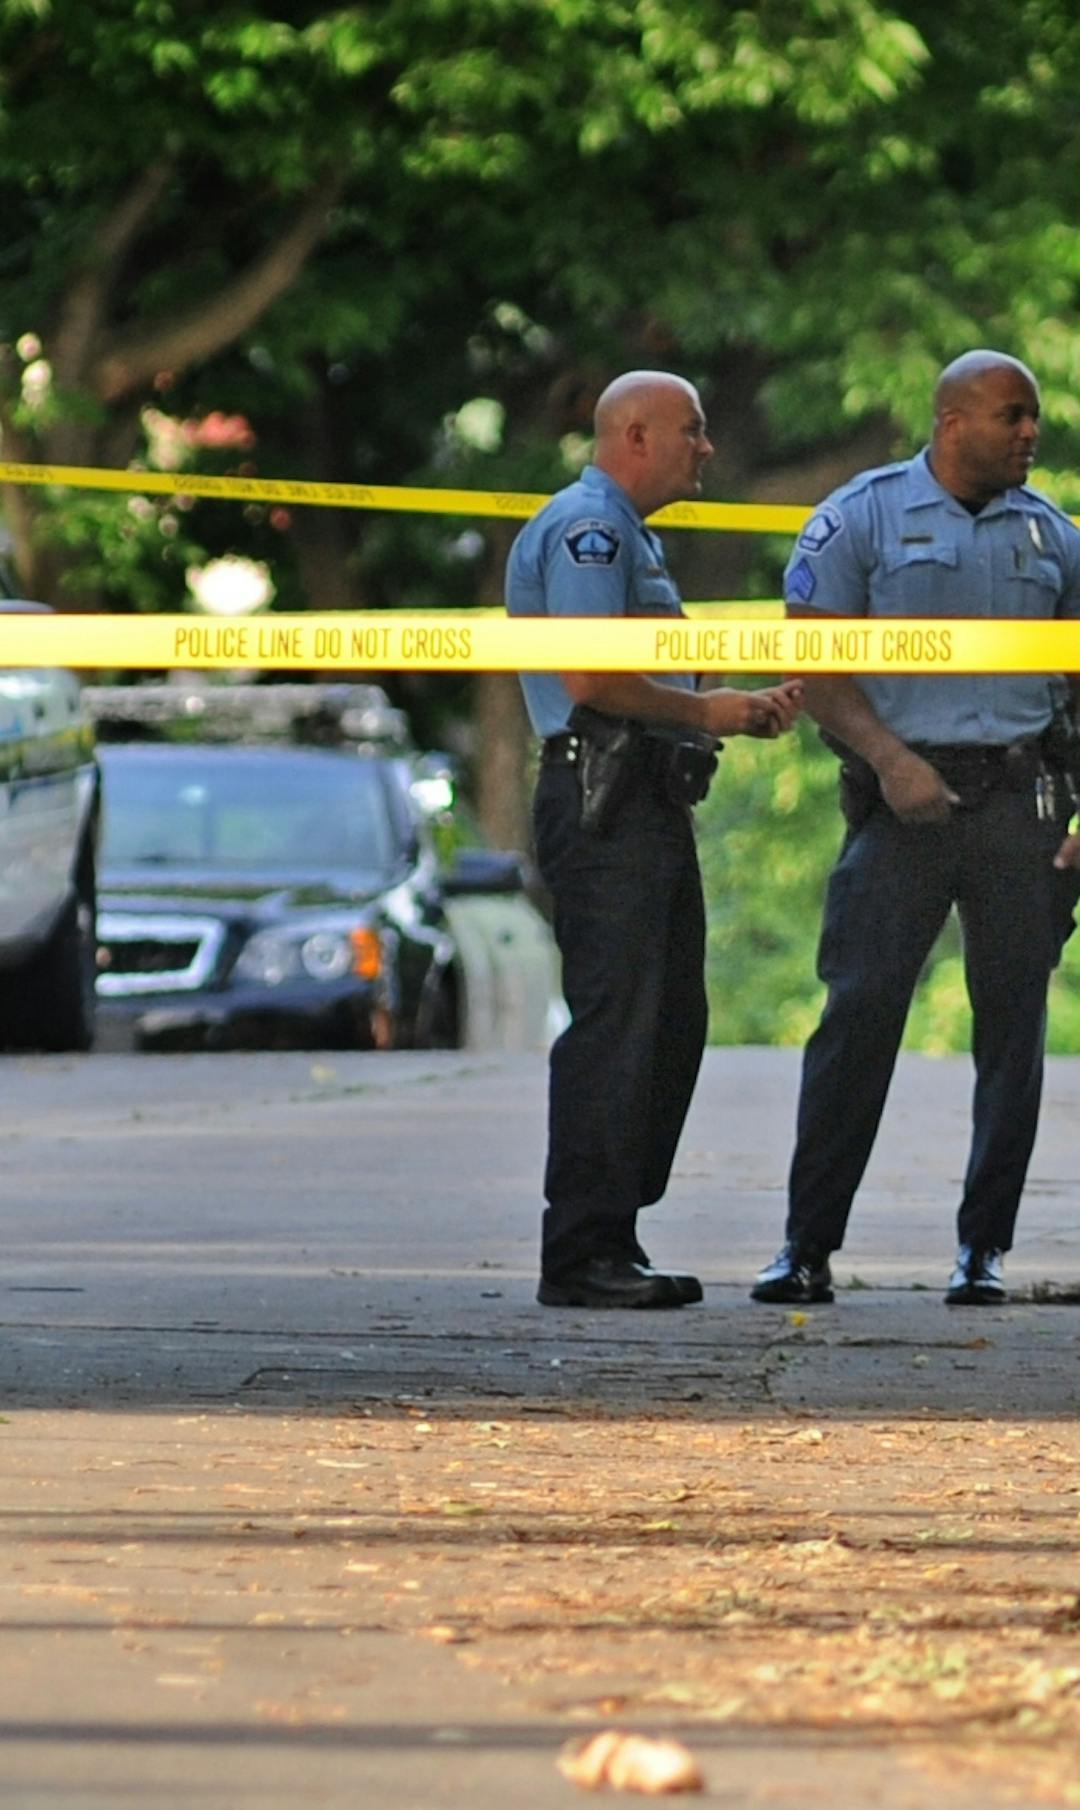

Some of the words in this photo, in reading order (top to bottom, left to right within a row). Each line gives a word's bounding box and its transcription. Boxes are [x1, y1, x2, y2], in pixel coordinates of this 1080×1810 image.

[174, 627, 247, 659] POLICE
[258, 627, 301, 659] LINE
[314, 628, 341, 659] DO
[351, 628, 390, 659] NOT
[401, 628, 472, 659] CROSS
[655, 629, 727, 662] POLICE
[738, 629, 782, 662] LINE
[795, 630, 822, 662] DO
[832, 630, 872, 662] NOT
[882, 629, 952, 662] CROSS
